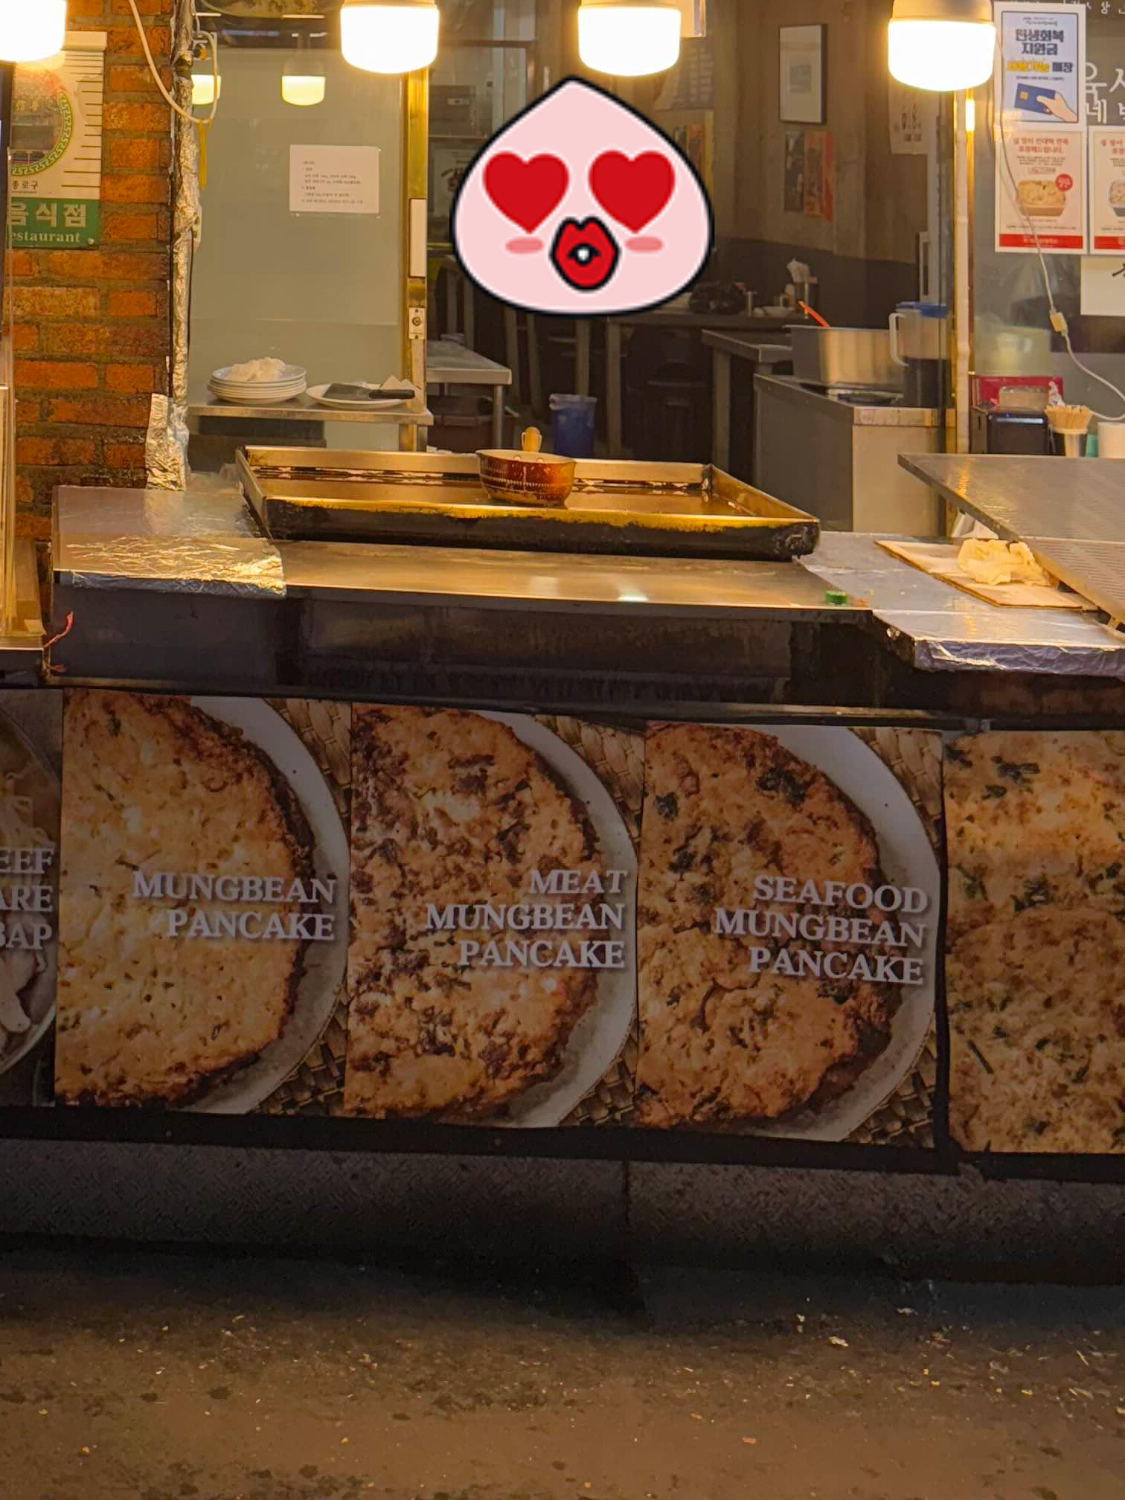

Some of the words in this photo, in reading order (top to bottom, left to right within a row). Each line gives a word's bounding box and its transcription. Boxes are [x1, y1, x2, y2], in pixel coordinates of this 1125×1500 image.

[7, 202, 88, 228] 음식점
[10, 230, 82, 244] estaurant
[131, 870, 337, 904] MUNGBEAN
[529, 869, 628, 897] MEAT
[752, 875, 929, 914] SEAFOOD
[166, 909, 336, 942] PANCAKE
[424, 902, 625, 932] MUNGBEAN
[713, 908, 926, 949] MUNGBEAN
[458, 940, 626, 970] PANCAKE
[747, 946, 925, 985] PANCAKE
